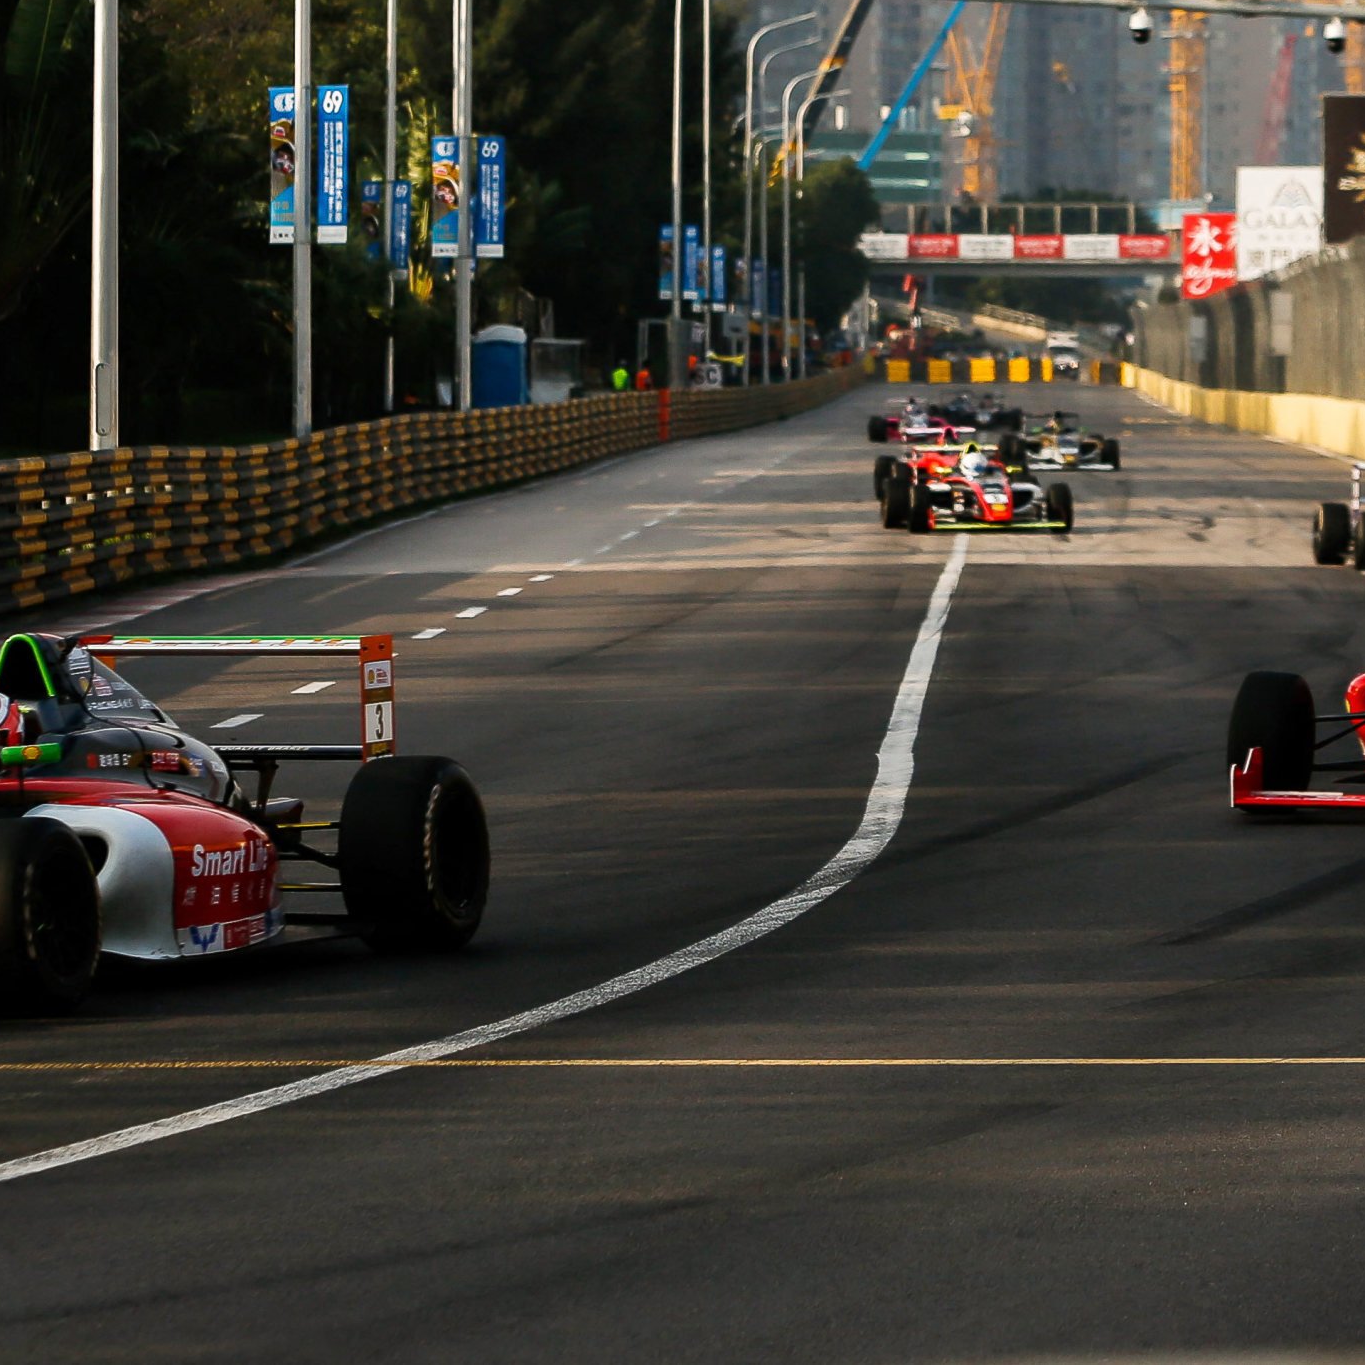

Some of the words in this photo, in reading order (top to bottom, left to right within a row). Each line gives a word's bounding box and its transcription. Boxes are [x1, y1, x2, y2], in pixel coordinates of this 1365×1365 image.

[322, 90, 343, 114] 69
[481, 141, 500, 158] 69
[375, 703, 384, 740] 3
[191, 843, 246, 877] Smart
